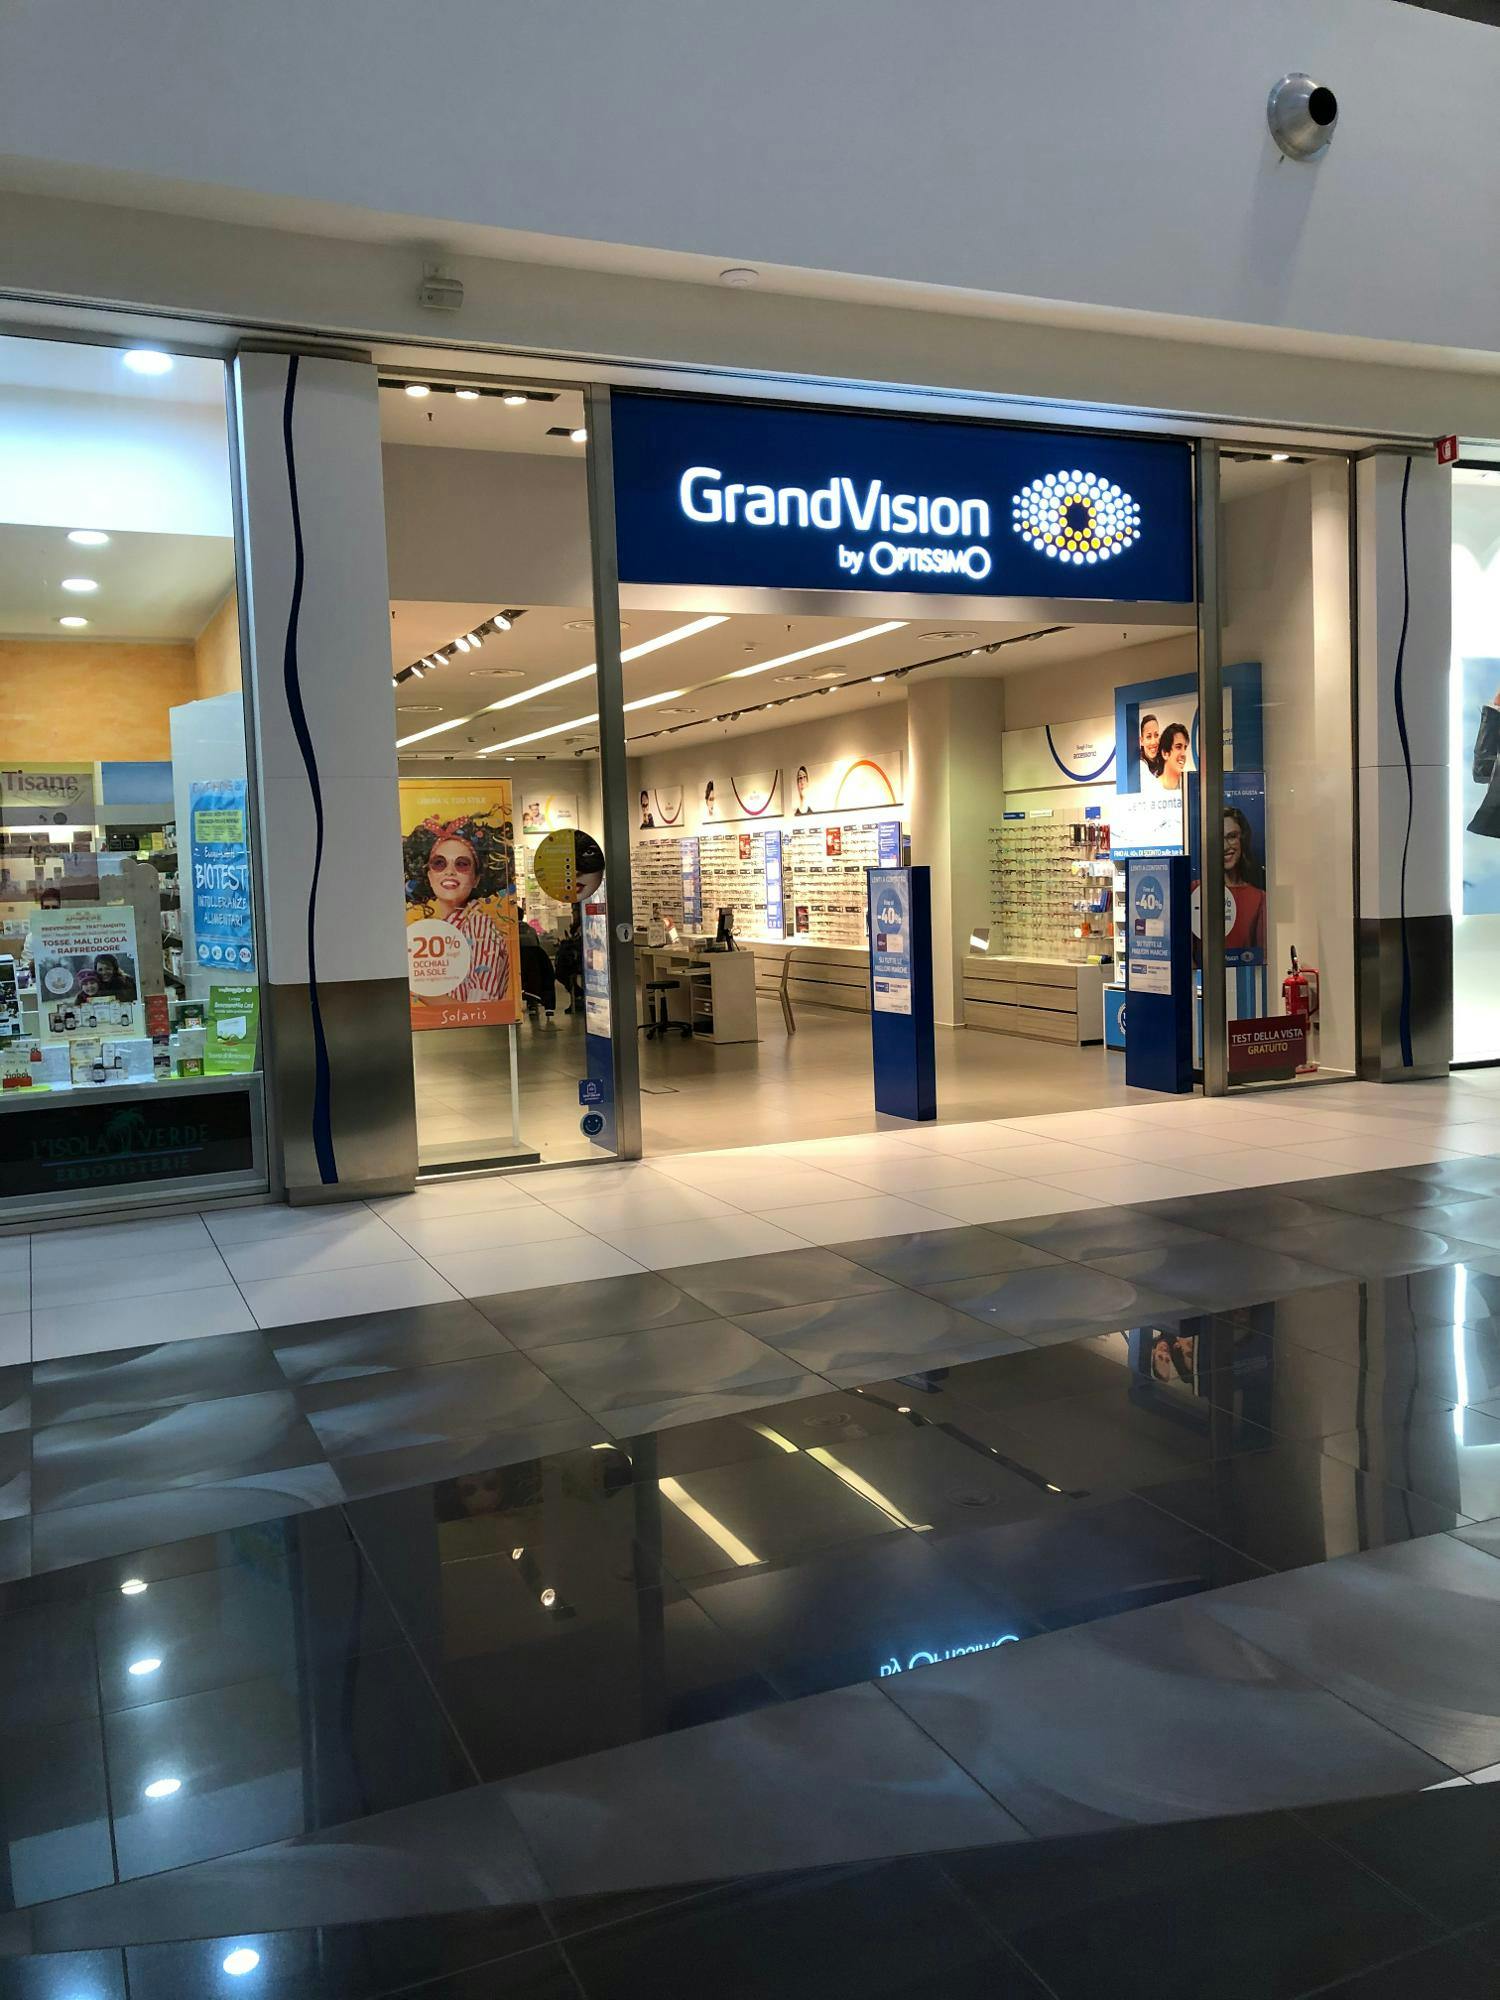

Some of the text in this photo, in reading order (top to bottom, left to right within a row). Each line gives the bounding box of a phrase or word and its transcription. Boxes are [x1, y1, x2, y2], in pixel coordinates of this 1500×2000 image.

[680, 465, 991, 537] GrandVision
[838, 544, 864, 574] by
[1, 769, 79, 792] Tisane
[194, 862, 248, 891] BIOTEST
[1135, 894, 1163, 910] -40%
[877, 907, 902, 924] -40%
[73, 938, 92, 946] MAL
[93, 937, 103, 945] DI
[103, 935, 128, 944] GOLA
[57, 945, 121, 955] RAFFREDDORE
[413, 960, 449, 969] OCCHIALI
[414, 968, 447, 977] DA SOLE
[440, 1007, 487, 1025] Solaris
[1231, 1028, 1304, 1044] TEST DELLA VISTA
[1247, 1042, 1289, 1055] GRATUITO
[138, 1123, 209, 1148] VERDE
[56, 1154, 191, 1182] ERBORISTERIE
